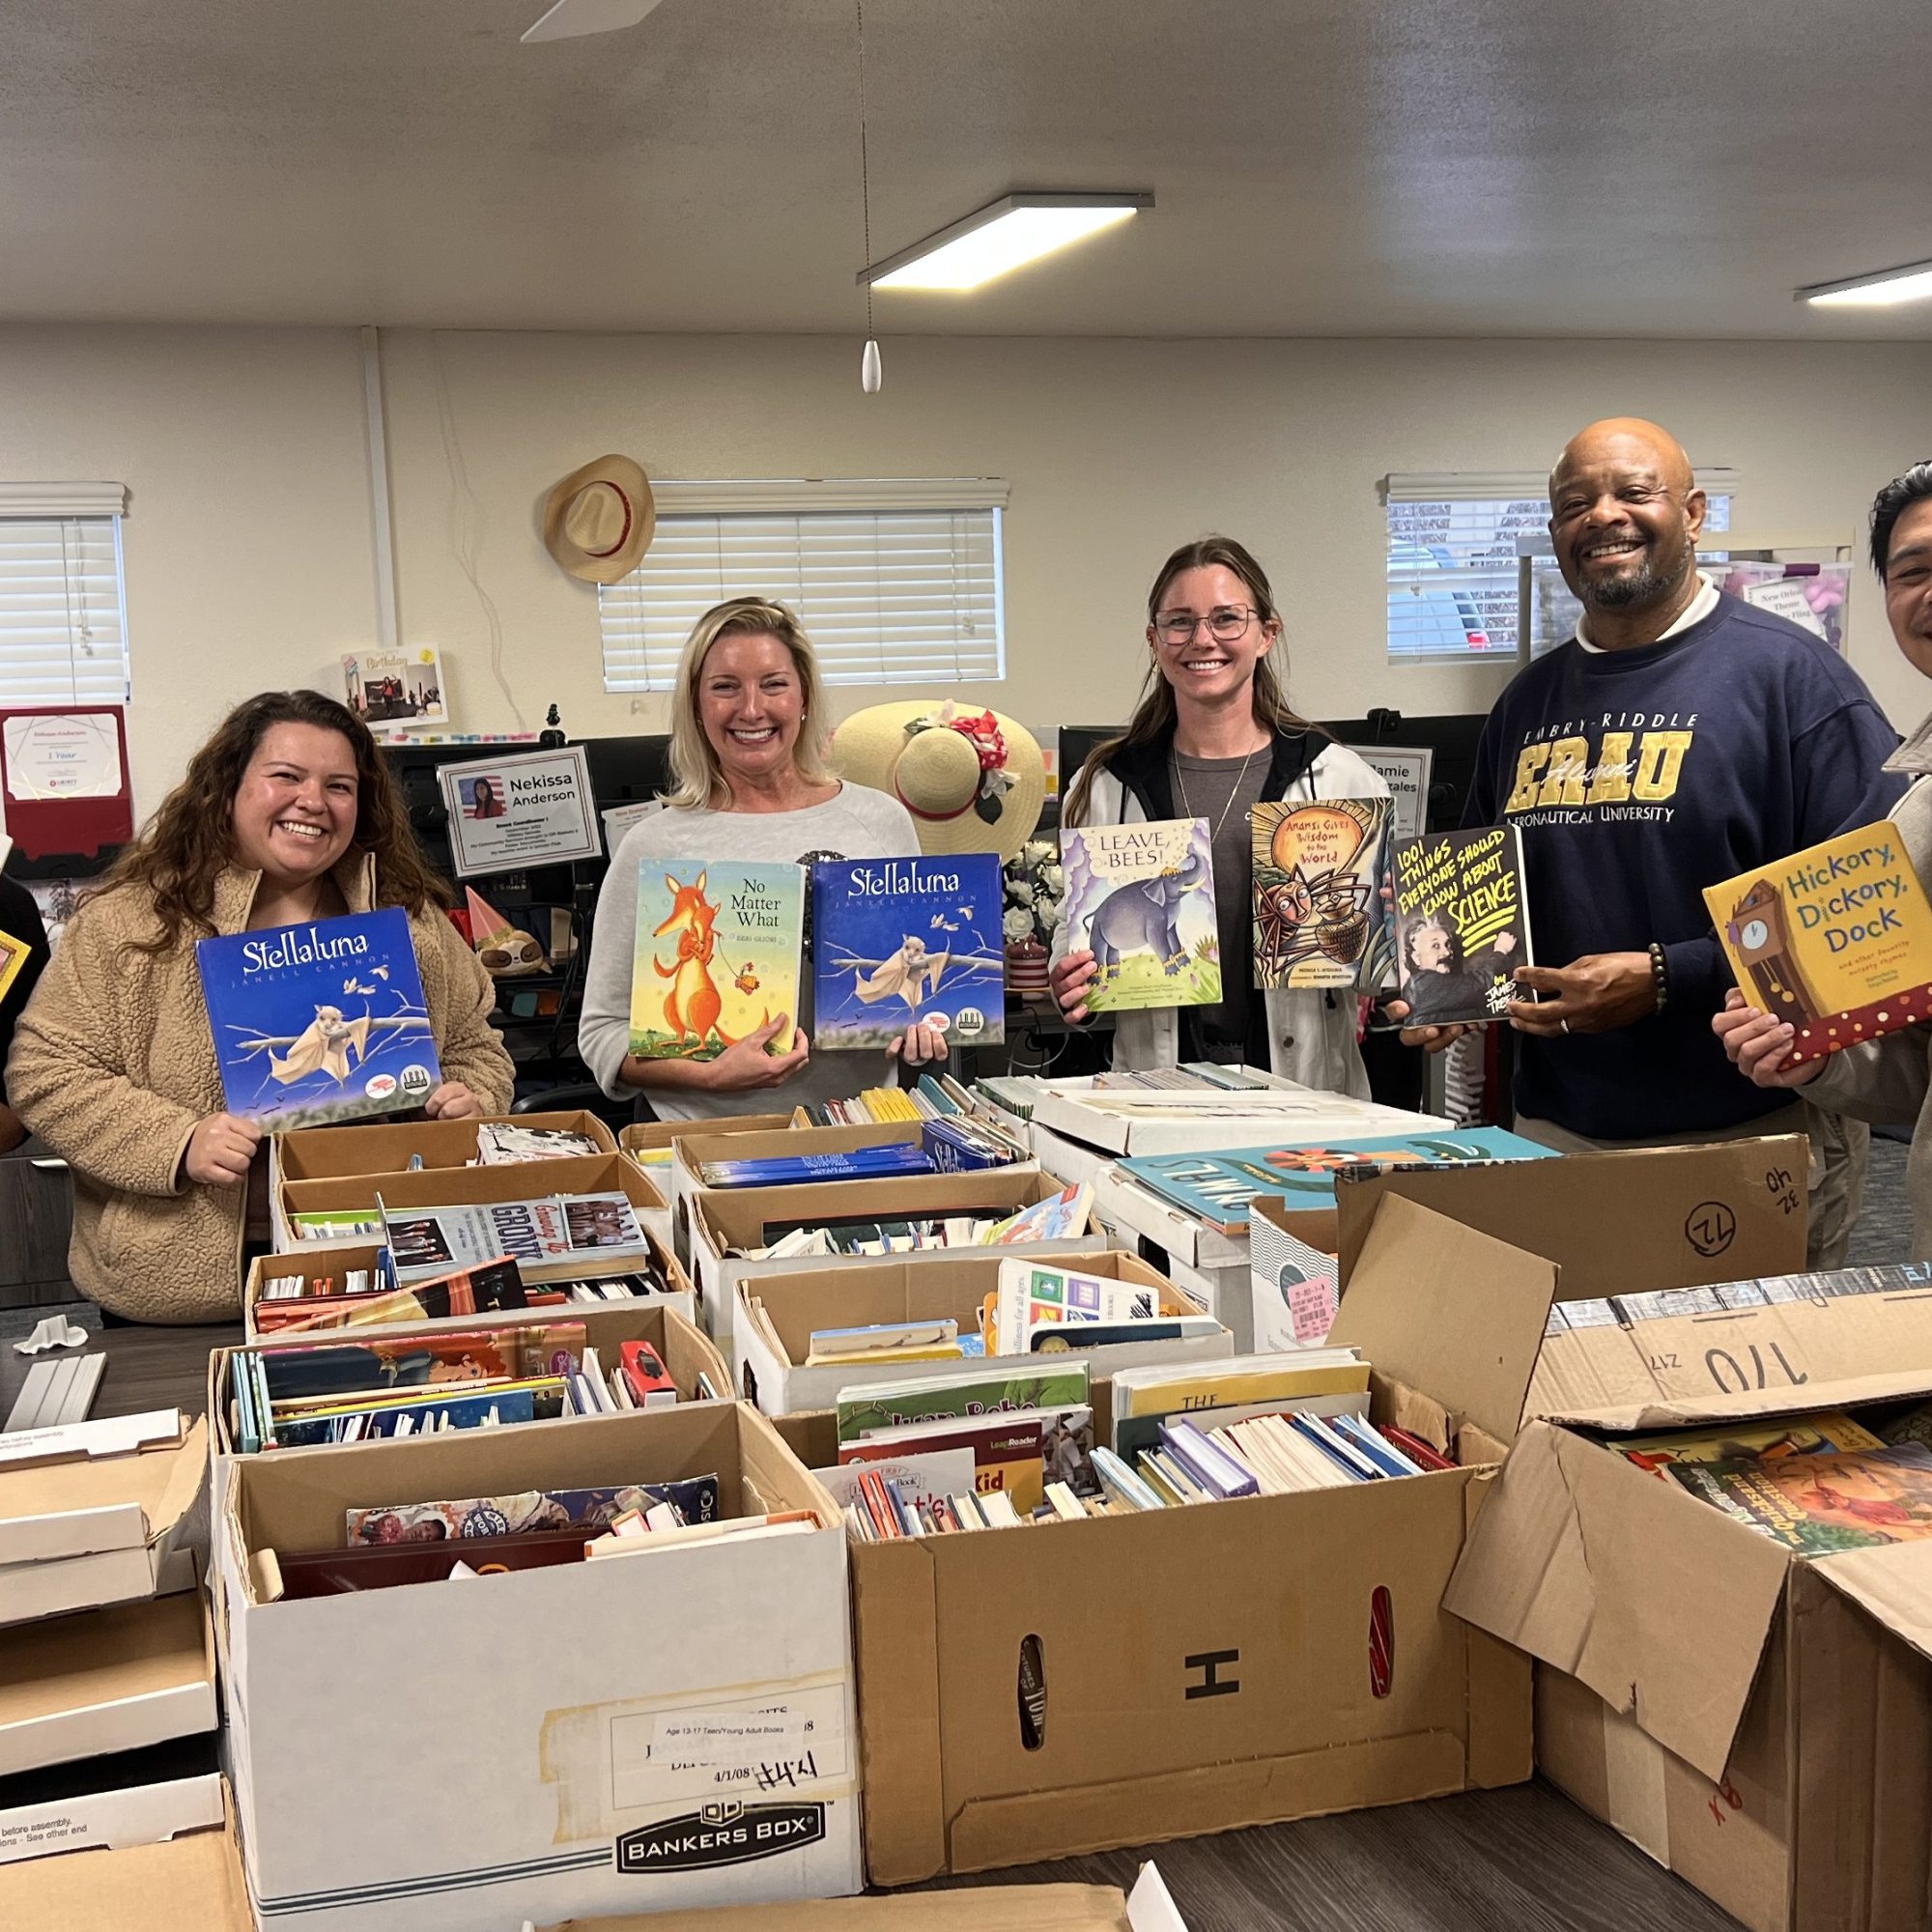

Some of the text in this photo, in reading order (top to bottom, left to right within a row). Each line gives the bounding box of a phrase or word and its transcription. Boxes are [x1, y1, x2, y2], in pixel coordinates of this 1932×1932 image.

[1774, 601, 1800, 611] Theme
[1523, 713, 1698, 744] EMBRY-RIDDLE
[510, 774, 573, 792] Nekissa
[1504, 730, 1693, 813] ERAU
[1541, 758, 1638, 784] Alumni
[513, 790, 576, 808] Anderson
[1286, 819, 1349, 832] Anansi Gives
[1601, 806, 1675, 822] UNIVERSITY
[1100, 832, 1171, 851] LEAVE,
[1296, 832, 1338, 842] Wisdom
[1109, 850, 1163, 867] BEES!
[1300, 852, 1338, 864] World
[1397, 838, 1425, 870] 1001
[1400, 838, 1451, 887] THINGS
[848, 861, 962, 899] Stellaluna
[1398, 831, 1505, 916] EVERYONE SHOULD
[1786, 843, 1895, 898] Hickory,
[743, 878, 766, 894] No
[1421, 850, 1503, 920] KNOW ABOUT
[731, 895, 781, 910] Matter
[910, 895, 977, 905] CANNON
[1447, 870, 1517, 934] SCIENCE
[1797, 874, 1908, 928] Dickory,
[737, 911, 781, 926] What
[1824, 906, 1903, 952] Dock
[242, 926, 370, 977] Stellaluna
[1838, 940, 1910, 969] and other favorite
[231, 953, 389, 989] JANELL CANNON
[1493, 973, 1507, 985] by
[1485, 978, 1517, 1002] JAMES
[1766, 1167, 1793, 1193] 40
[1776, 1189, 1801, 1215] 32
[491, 1204, 544, 1260] GRONK
[535, 1205, 558, 1238] Growing
[1181, 1393, 1219, 1407] THE
[990, 1435, 1037, 1449] LeapReader
[1722, 1472, 1797, 1531] Quicksand
[1748, 1471, 1809, 1520] Question
[667, 1727, 680, 1736] Age
[703, 1727, 744, 1736] Teen/Young
[763, 1725, 784, 1734] Books
[714, 1767, 751, 1783] 4/1/08
[2, 1817, 71, 1836] before assembly.
[26, 1833, 44, 1842] See
[46, 1828, 69, 1839] other
[71, 1824, 88, 1834] end
[628, 1817, 807, 1861] BANKERS BOX
